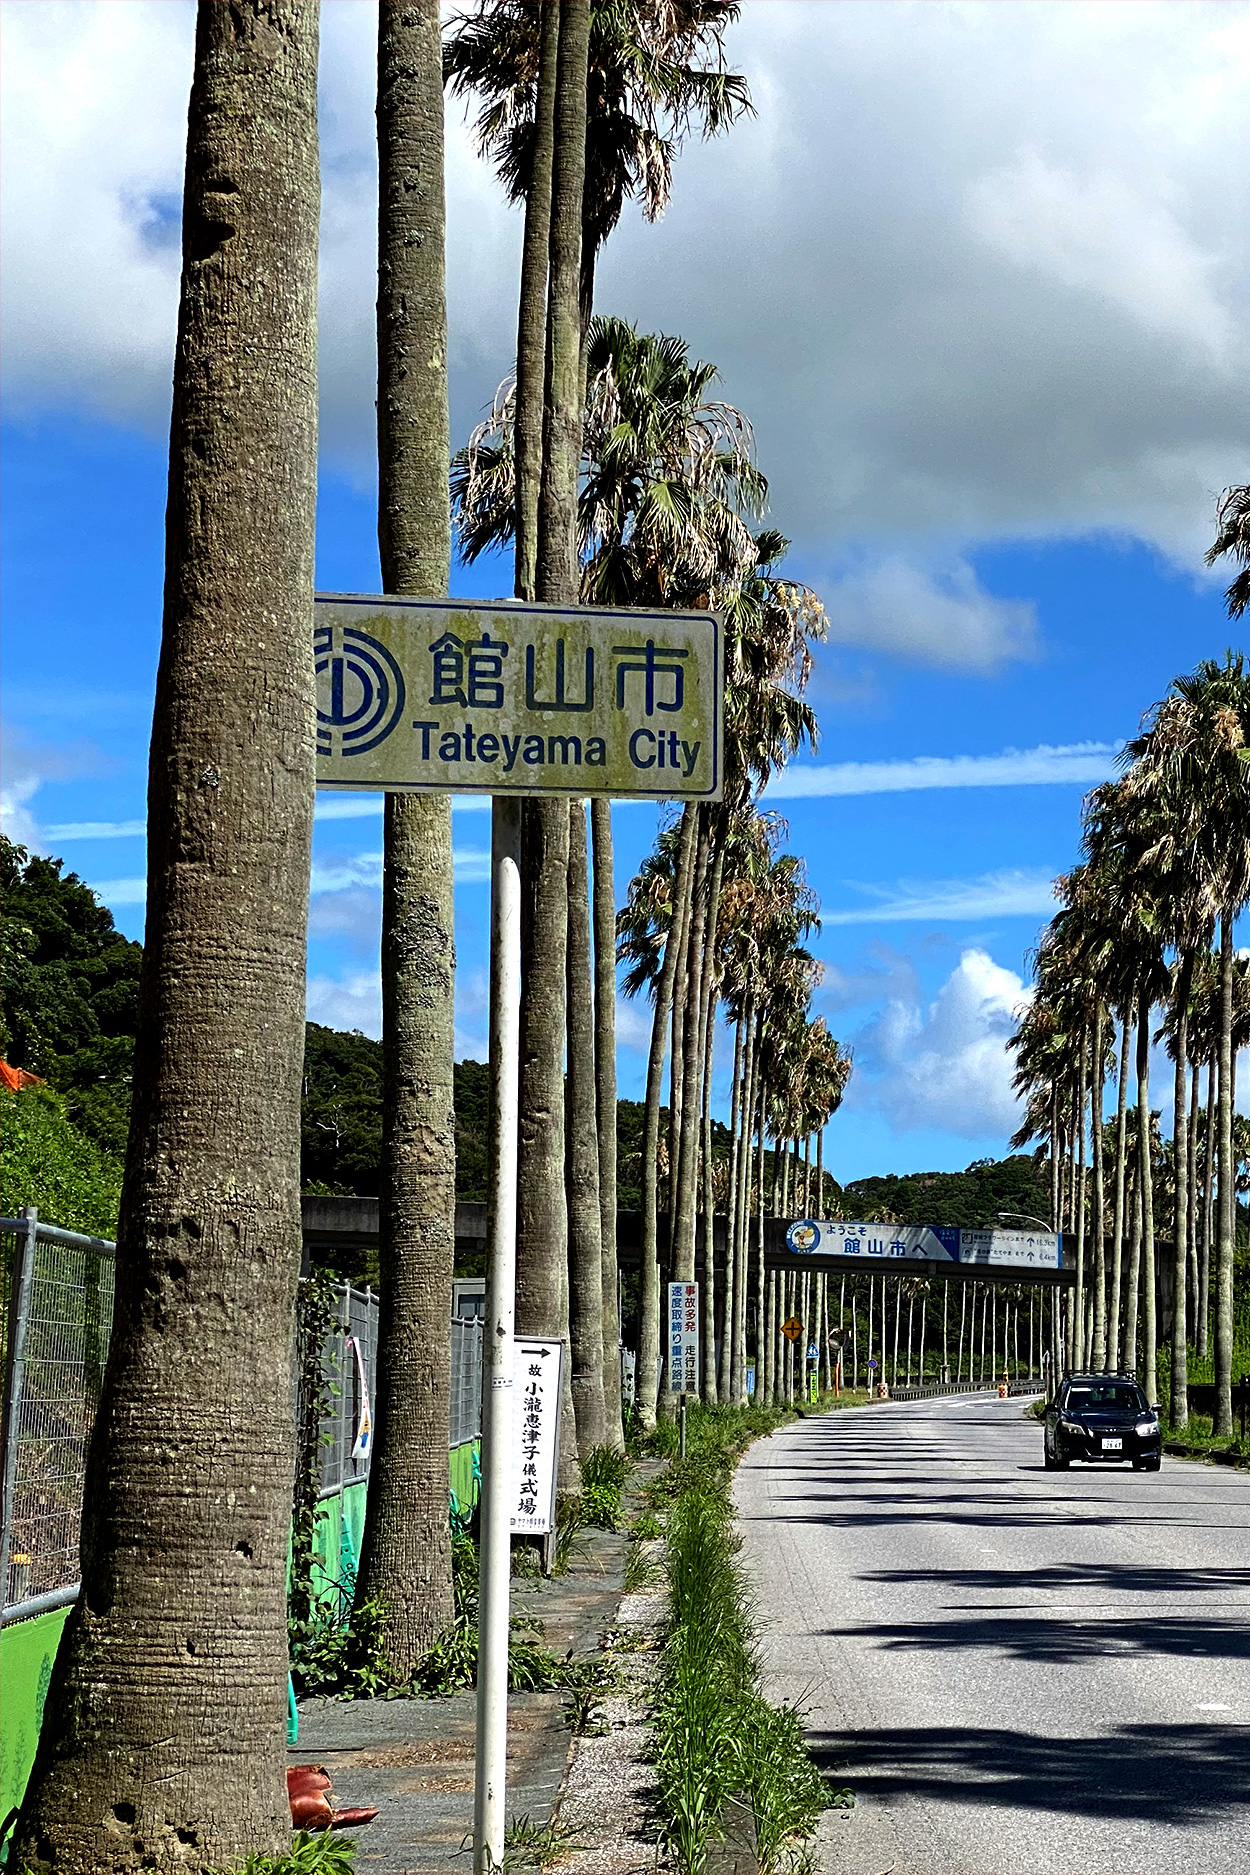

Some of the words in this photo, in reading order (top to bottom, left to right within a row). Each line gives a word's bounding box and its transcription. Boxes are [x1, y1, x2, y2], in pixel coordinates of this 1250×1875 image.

[428, 632, 689, 716] 館山市
[412, 721, 606, 772] Tateyama
[629, 728, 701, 778] City
[827, 1225, 867, 1236] ようこそ
[844, 1238, 928, 1256] 館山市へ
[684, 1286, 696, 1332] 事故多発
[671, 1286, 682, 1392] 速度取締り重点路線
[684, 1345, 696, 1391] 走行注意
